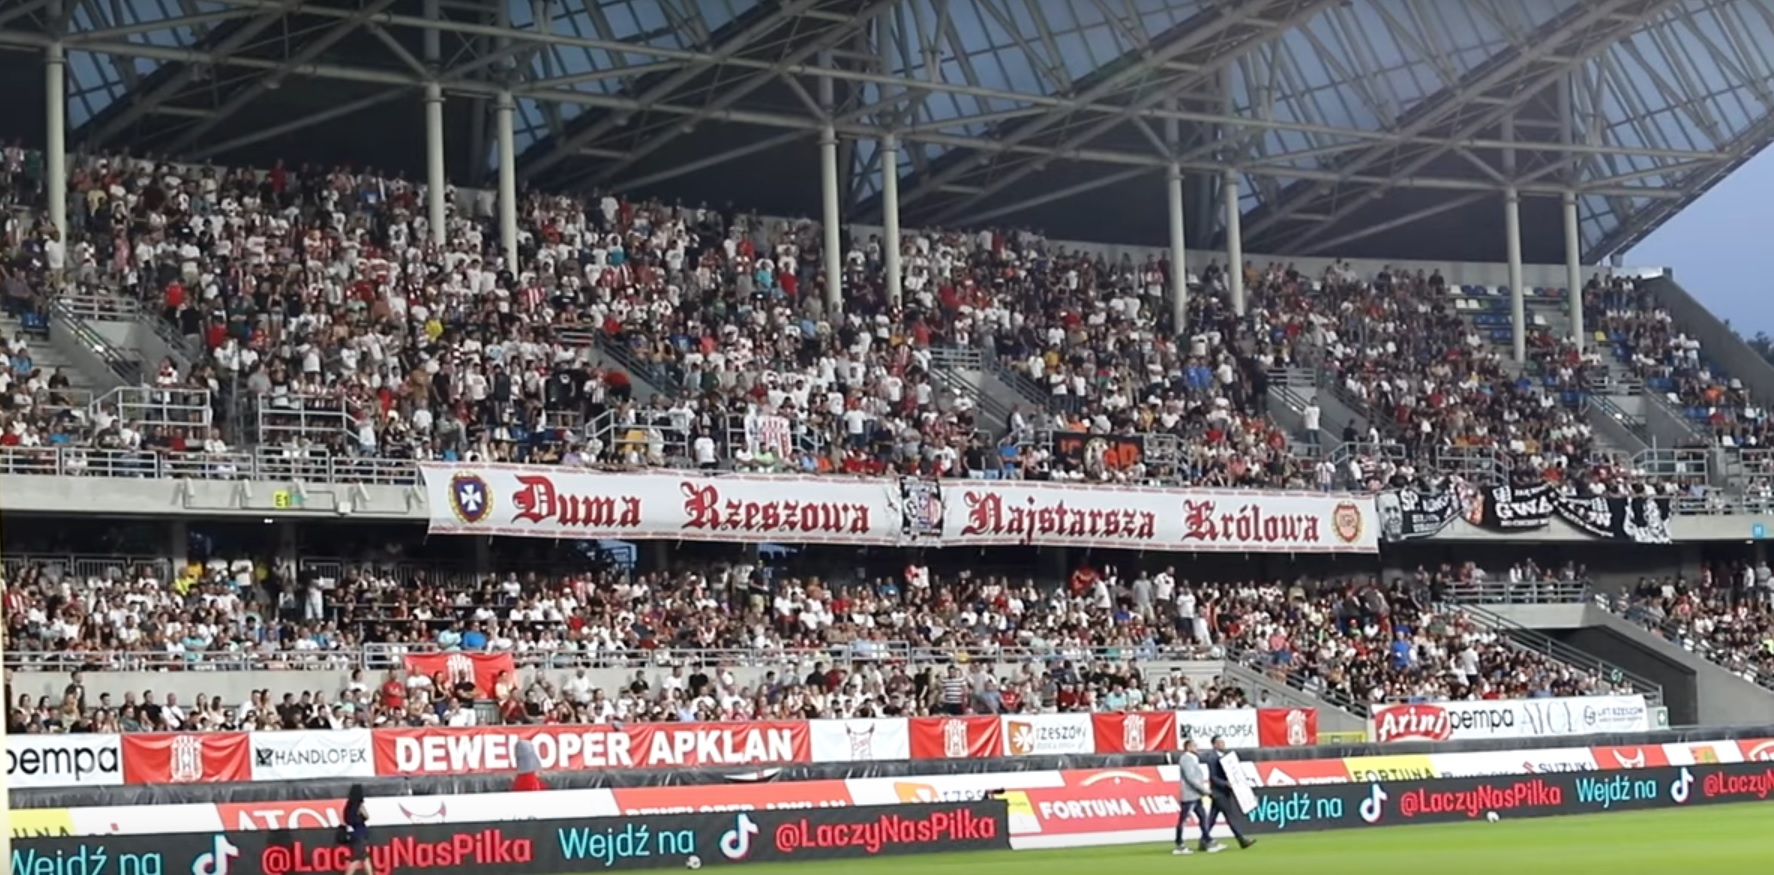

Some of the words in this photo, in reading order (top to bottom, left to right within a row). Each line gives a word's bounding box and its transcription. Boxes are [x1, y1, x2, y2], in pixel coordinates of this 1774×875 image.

[511, 474, 641, 527] Duma
[680, 480, 870, 535] Rzeszowa
[961, 490, 1156, 545] Najstarsza
[1182, 497, 1320, 544] Królowa
[1379, 707, 1445, 742] Arini
[1450, 708, 1515, 734] pempa
[275, 747, 367, 766] HANDLOPEX
[395, 732, 633, 772] DEWELOPER
[648, 729, 793, 765] APKLAN
[1038, 796, 1136, 821] FORTUNA
[1317, 798, 1343, 818] na
[1401, 779, 1562, 818] @LaczyNasPilka
[1576, 775, 1631, 808] Wejdź
[1635, 779, 1657, 799] na
[558, 823, 650, 867] Wejdź
[658, 829, 695, 855] na
[775, 808, 997, 853] @LaczyNasPilka
[119, 852, 162, 875] na
[262, 828, 533, 875] @LacyNasPilka
